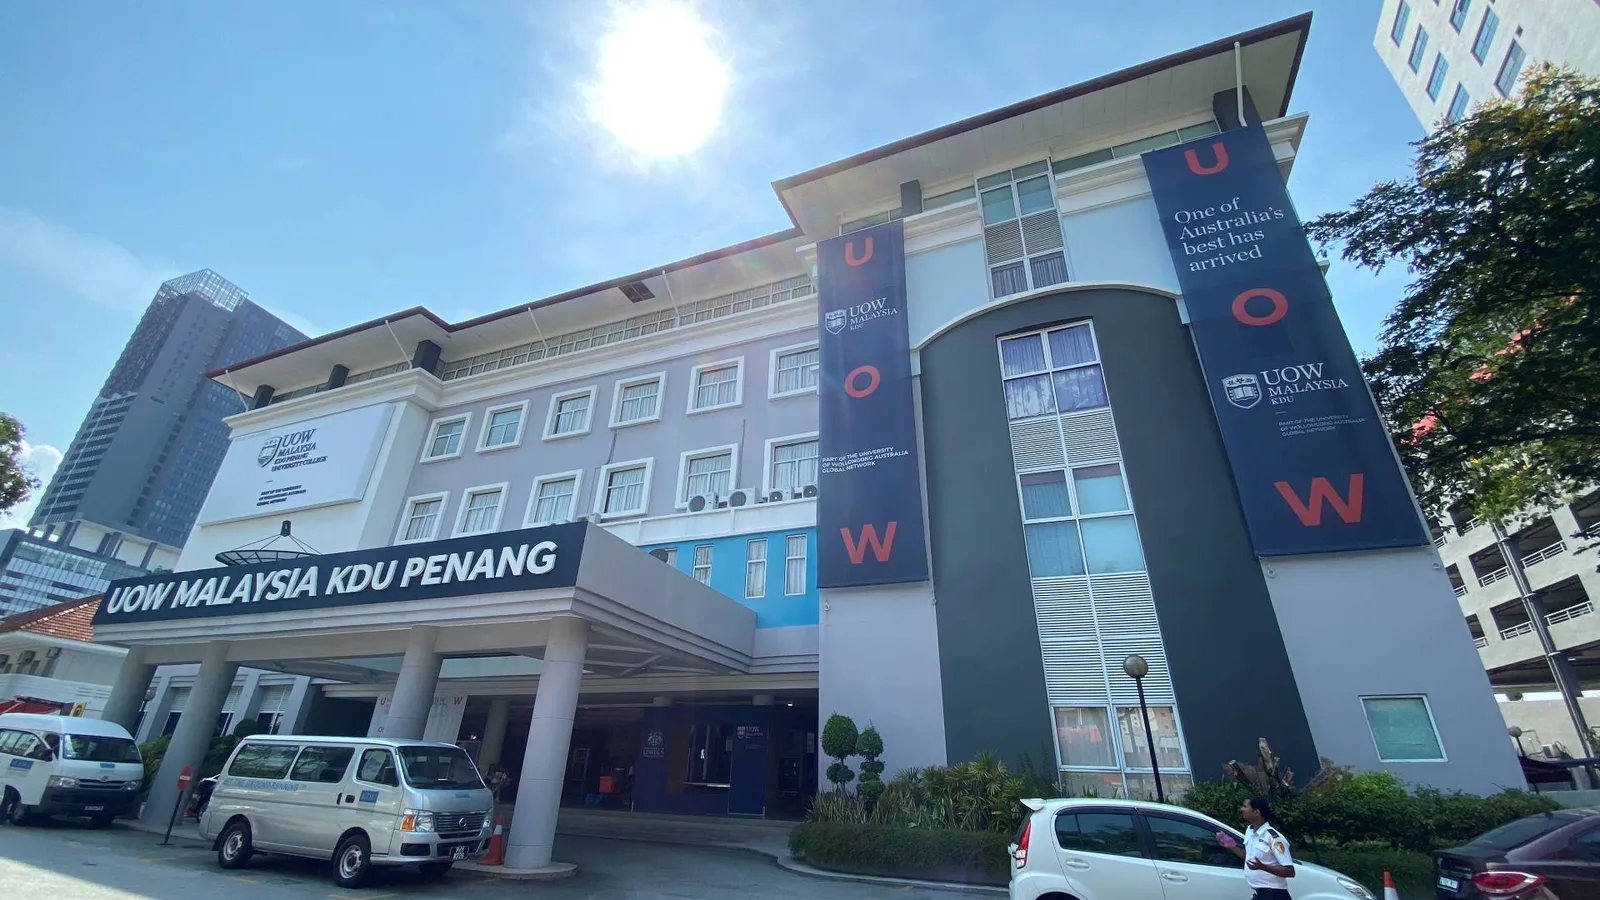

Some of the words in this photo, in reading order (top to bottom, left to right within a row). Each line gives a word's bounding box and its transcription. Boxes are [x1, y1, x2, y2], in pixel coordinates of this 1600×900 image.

[1184, 141, 1229, 175] U
[1174, 207, 1215, 224] One
[1220, 197, 1240, 213] of
[1180, 207, 1284, 240] Australia's
[845, 236, 874, 267] U
[1182, 237, 1226, 255] best
[1228, 230, 1265, 246] has
[1189, 244, 1263, 272] arrived
[849, 297, 887, 317] UOW
[850, 307, 898, 325] MALAYSIA
[1231, 288, 1288, 326] O
[844, 365, 881, 398] O
[1260, 362, 1324, 386] UOW
[1267, 378, 1349, 397] MALAYSIA
[1271, 396, 1294, 405] KDU
[277, 442, 317, 457] MALAYSIA
[282, 428, 317, 447] UOW
[831, 455, 873, 468] WOLLONGONG
[874, 449, 909, 460] AUSTRALIA
[859, 446, 894, 457] UNIVERSITY
[846, 460, 876, 471] NETWORK
[1274, 473, 1364, 527] W
[840, 521, 897, 564] W
[106, 582, 176, 614] UOW
[170, 566, 319, 609] MALAYSIA
[325, 559, 399, 595] KDU
[399, 541, 558, 587] PENANG
